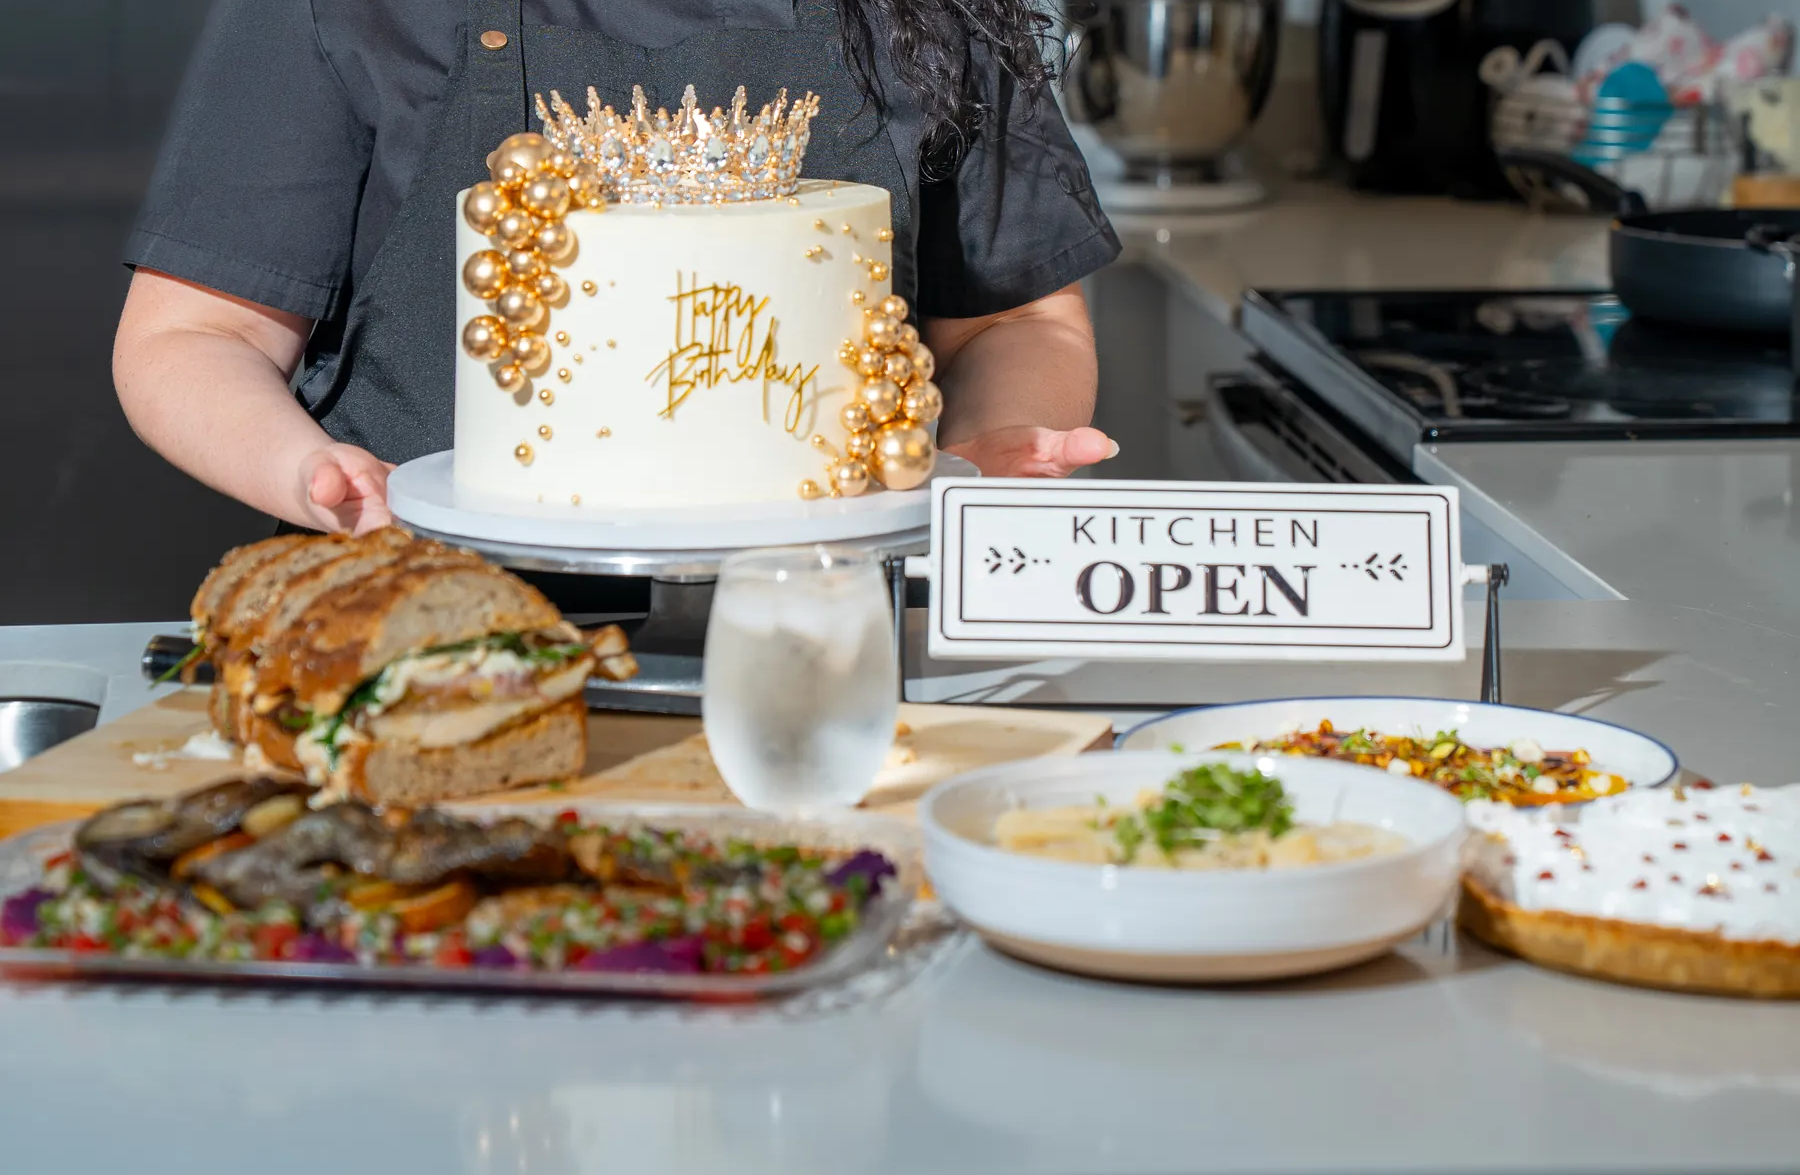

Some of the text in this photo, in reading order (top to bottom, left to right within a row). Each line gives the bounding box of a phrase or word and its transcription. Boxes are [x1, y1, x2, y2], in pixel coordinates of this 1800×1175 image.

[666, 270, 771, 366] Happy
[645, 317, 820, 433] Birthday
[1072, 515, 1320, 549] KITCHEN
[1076, 560, 1318, 618] OPEN
